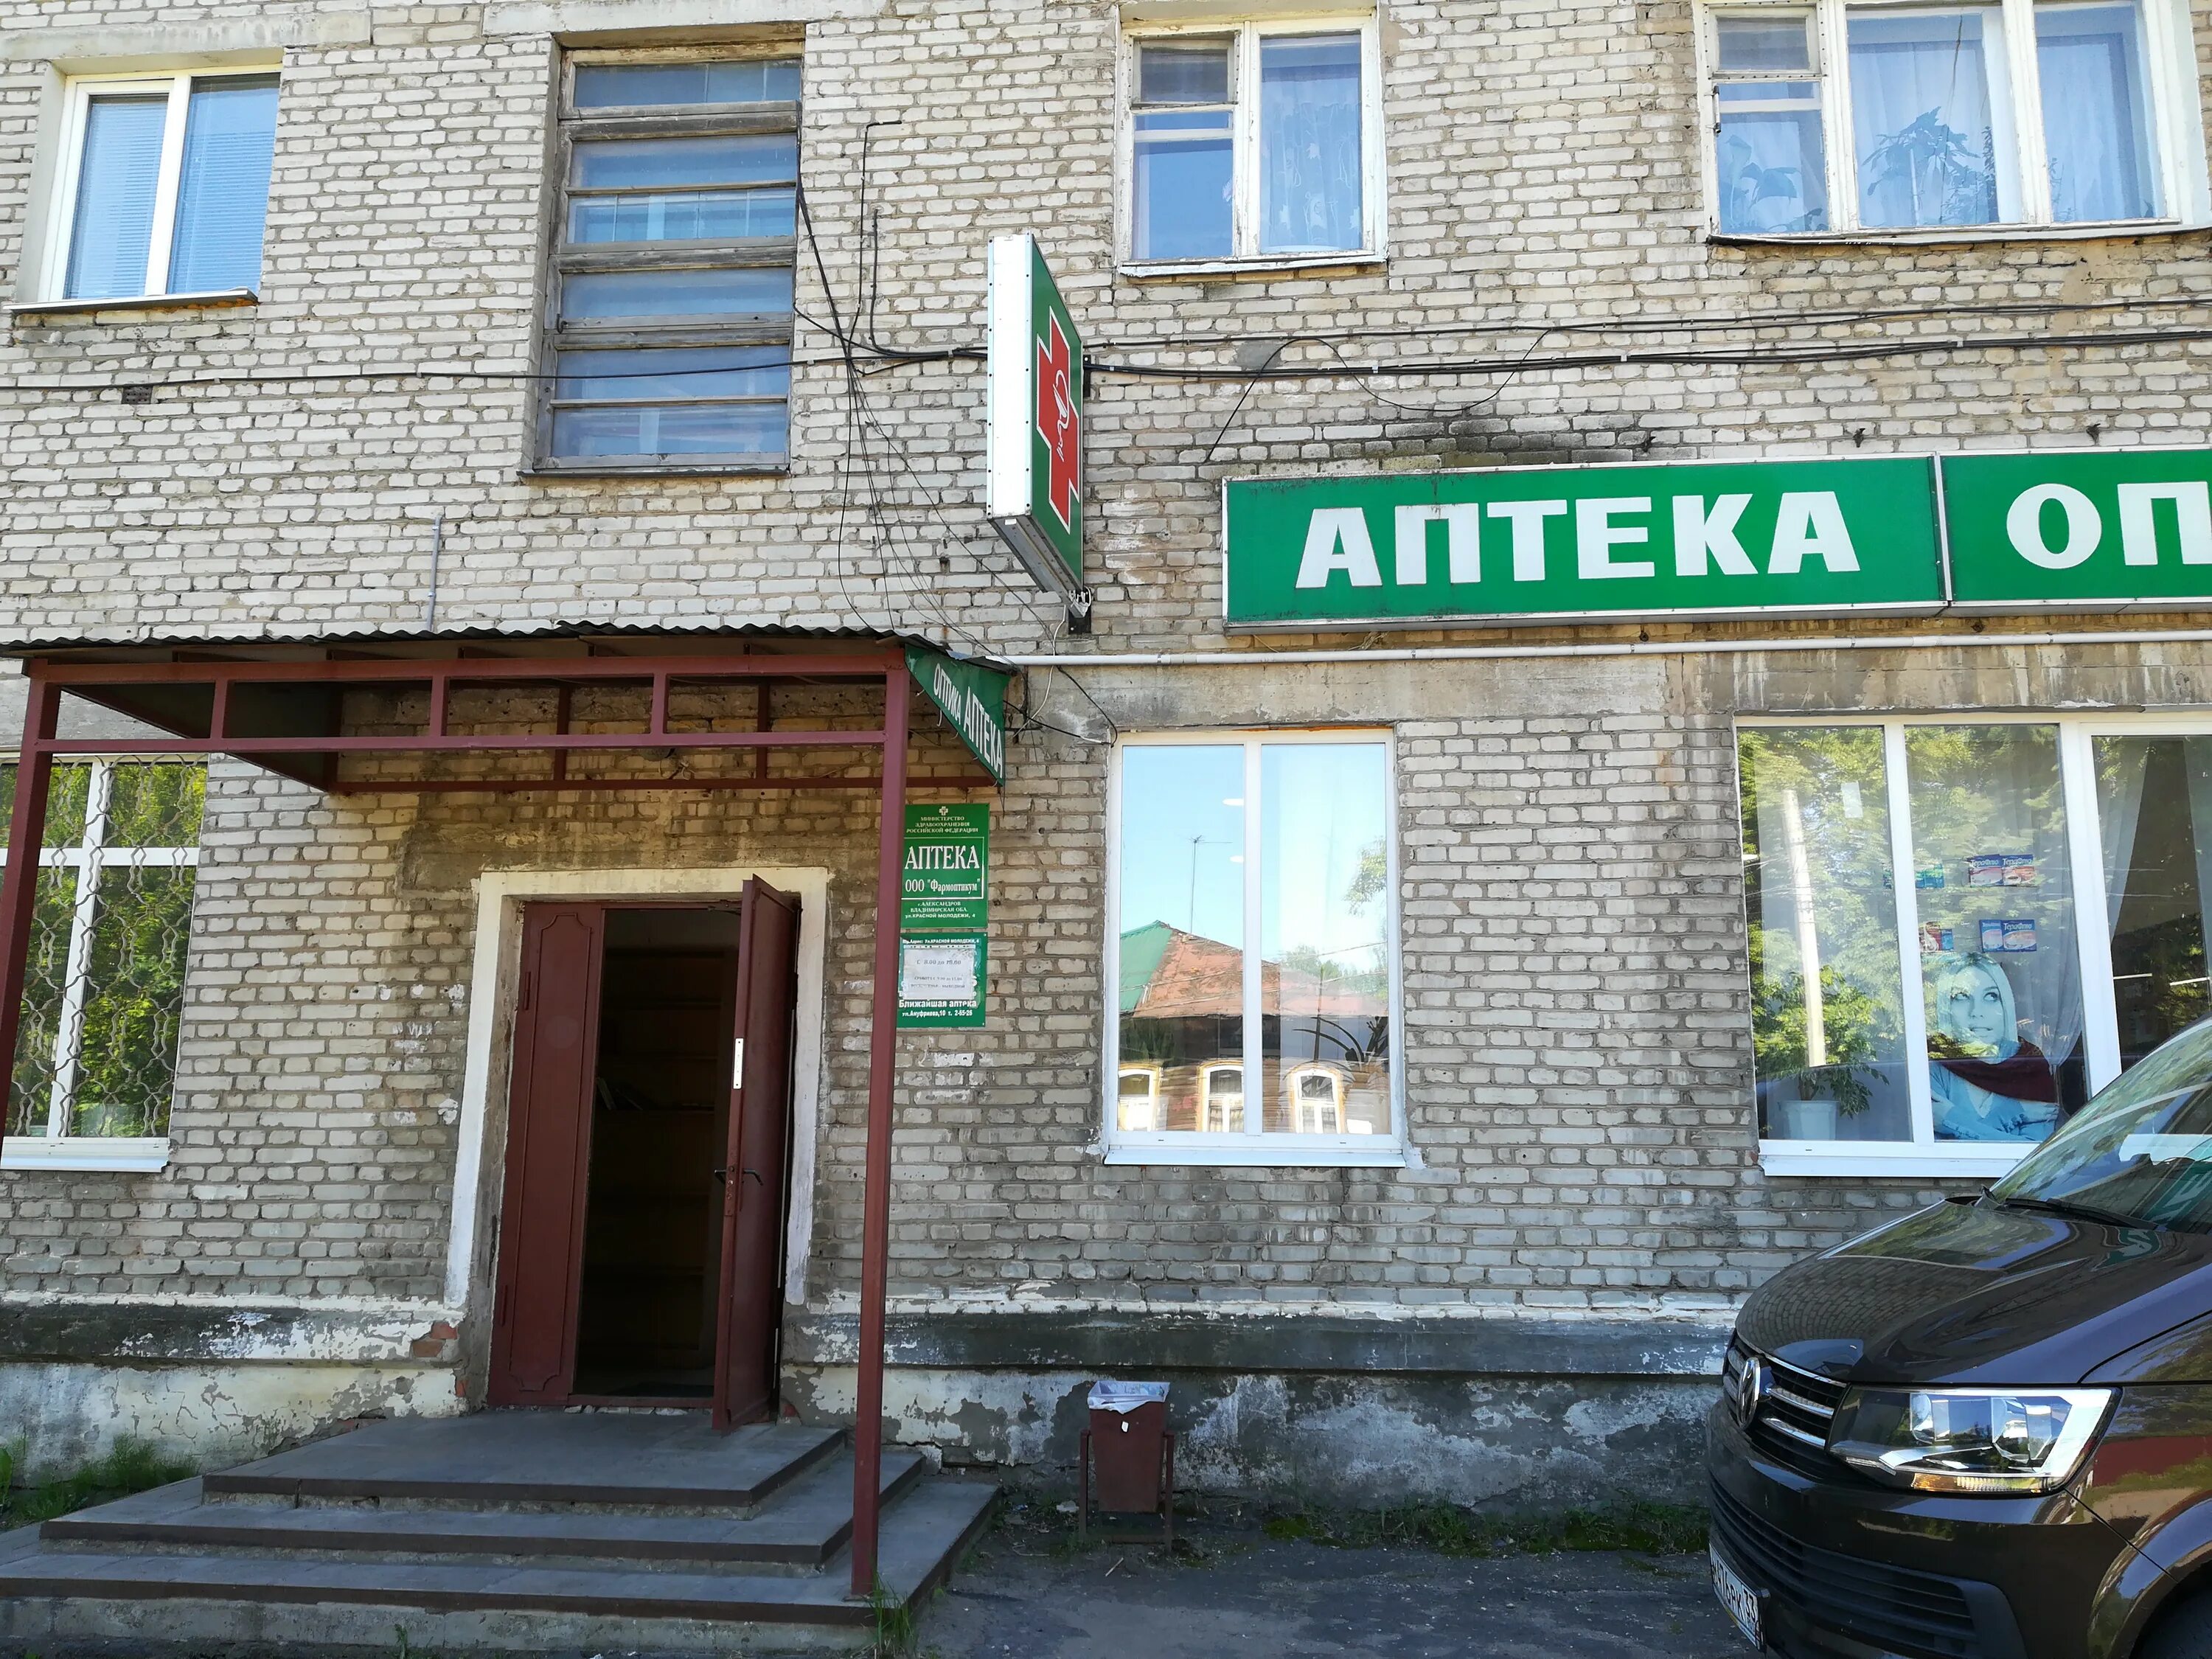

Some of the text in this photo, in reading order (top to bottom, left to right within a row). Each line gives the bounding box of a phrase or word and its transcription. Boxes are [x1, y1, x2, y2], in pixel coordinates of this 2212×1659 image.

[1295, 481, 2212, 588] АПТЕКА ОП
[933, 663, 1003, 779] ОПТИКА АПТЕКА
[904, 845, 981, 869] АПТЕКА
[905, 879, 925, 892] ООО
[898, 998, 978, 1008] Ближайшая аптека
